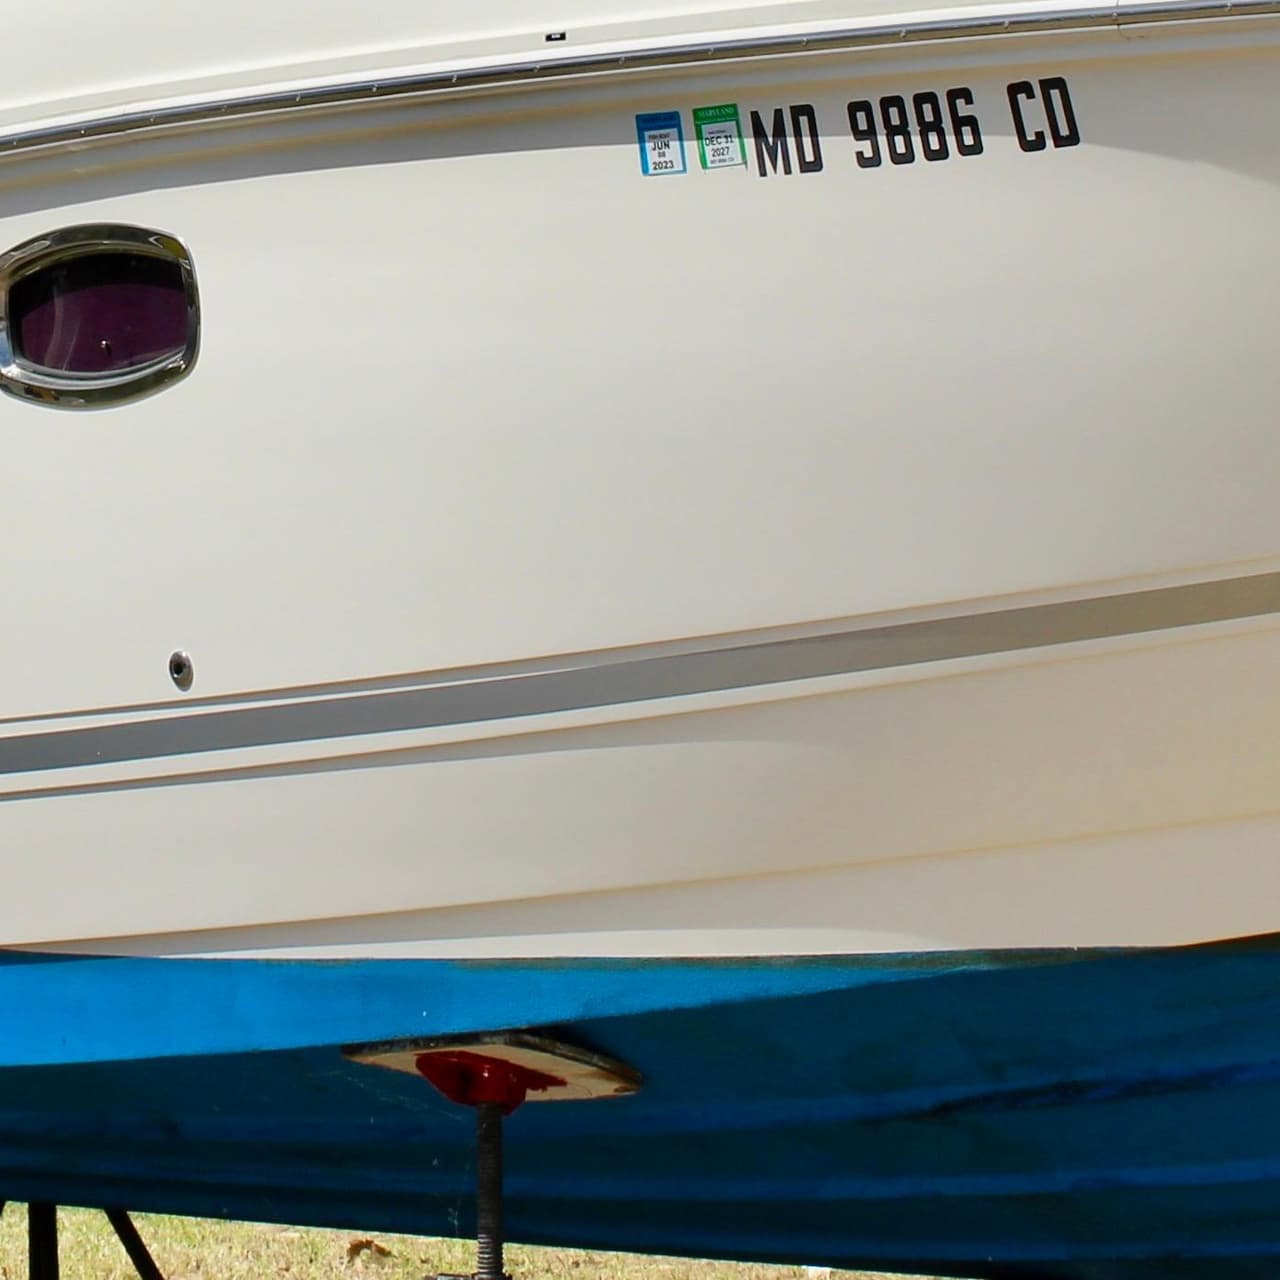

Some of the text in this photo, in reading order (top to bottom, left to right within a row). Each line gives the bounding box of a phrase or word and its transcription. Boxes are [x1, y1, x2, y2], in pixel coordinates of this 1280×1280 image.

[750, 77, 1081, 177] MD 9886 CD
[651, 140, 670, 151] JUN
[705, 136, 723, 147] DEC
[711, 146, 731, 157] 2027
[652, 160, 674, 170] 2023
